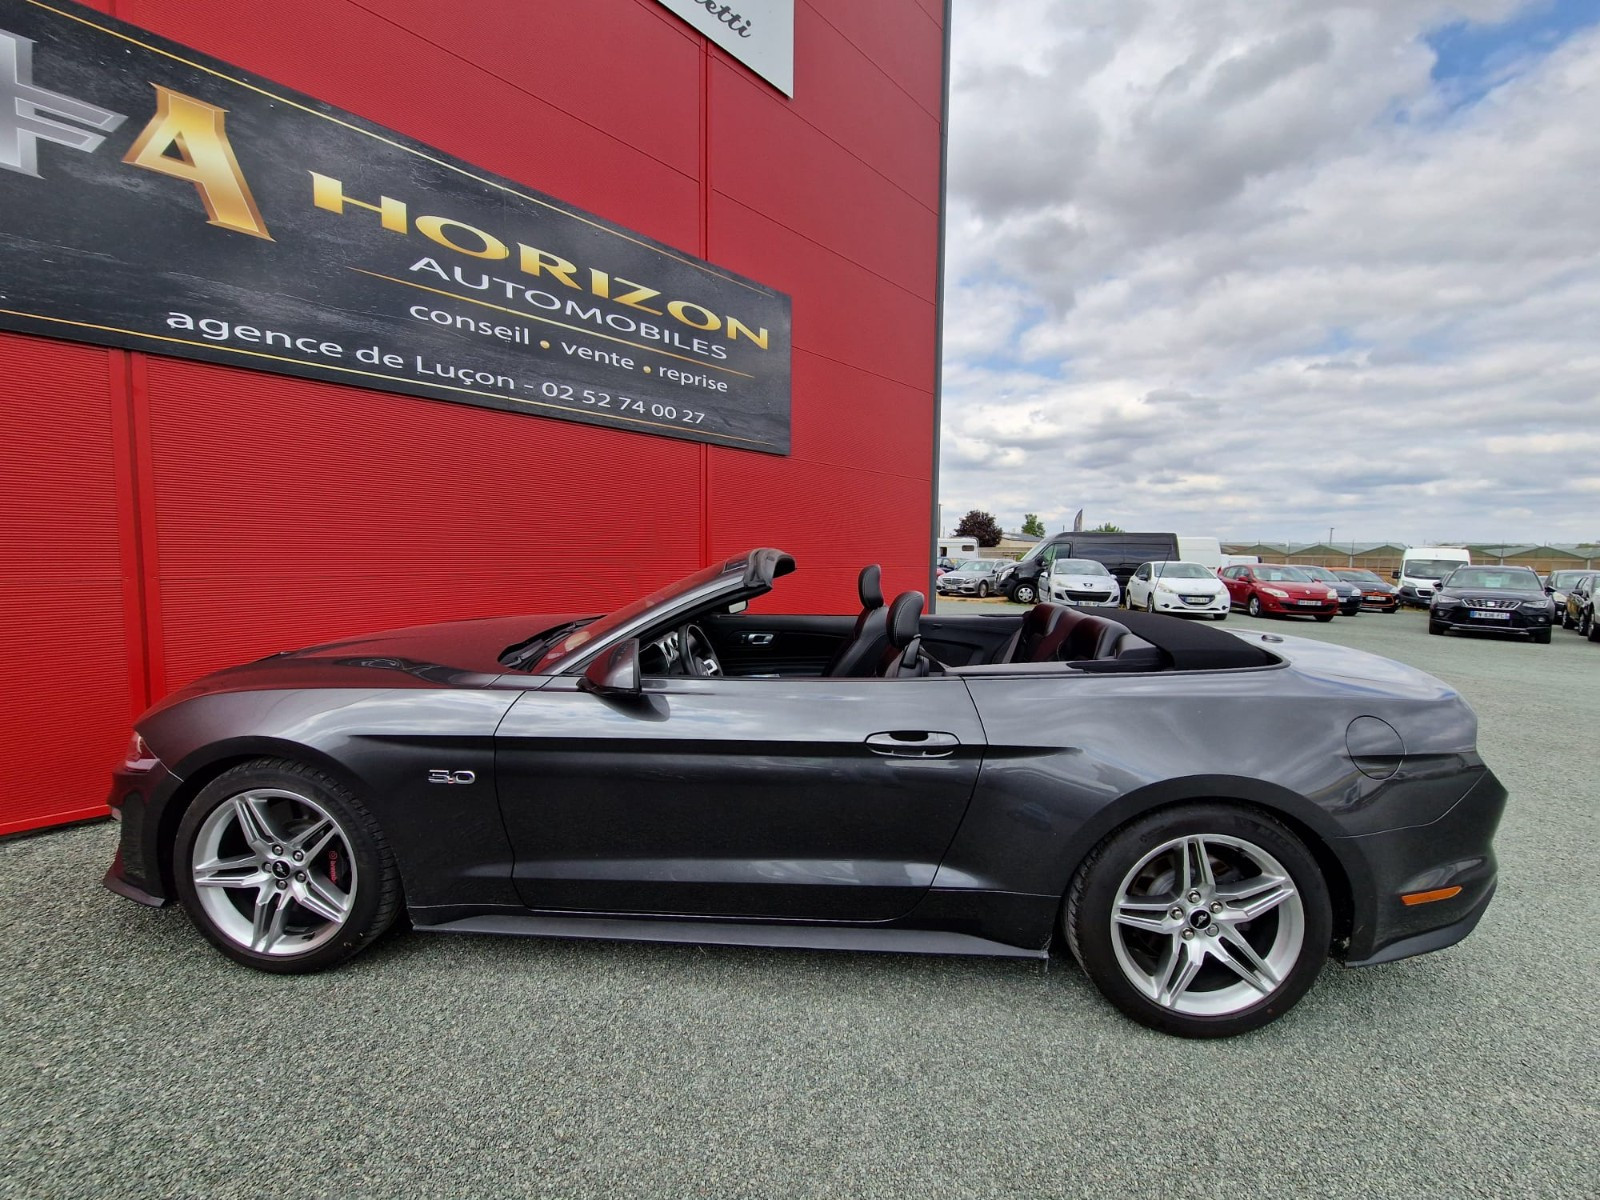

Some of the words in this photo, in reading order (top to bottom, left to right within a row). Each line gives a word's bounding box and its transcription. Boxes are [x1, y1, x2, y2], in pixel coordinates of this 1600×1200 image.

[694, 0, 751, 38] etti
[308, 170, 769, 350] HORIZON
[409, 257, 727, 359] AUTOMOBILES
[166, 311, 343, 358] agence
[355, 346, 404, 369] de
[416, 355, 515, 390] Luçon
[541, 381, 574, 400] 02
[582, 389, 611, 408] 52
[618, 397, 646, 414] 74
[651, 403, 677, 420] 00
[682, 409, 705, 424] 27
[409, 305, 530, 345] conseil
[561, 341, 635, 370] vente
[658, 365, 728, 393] reprise
